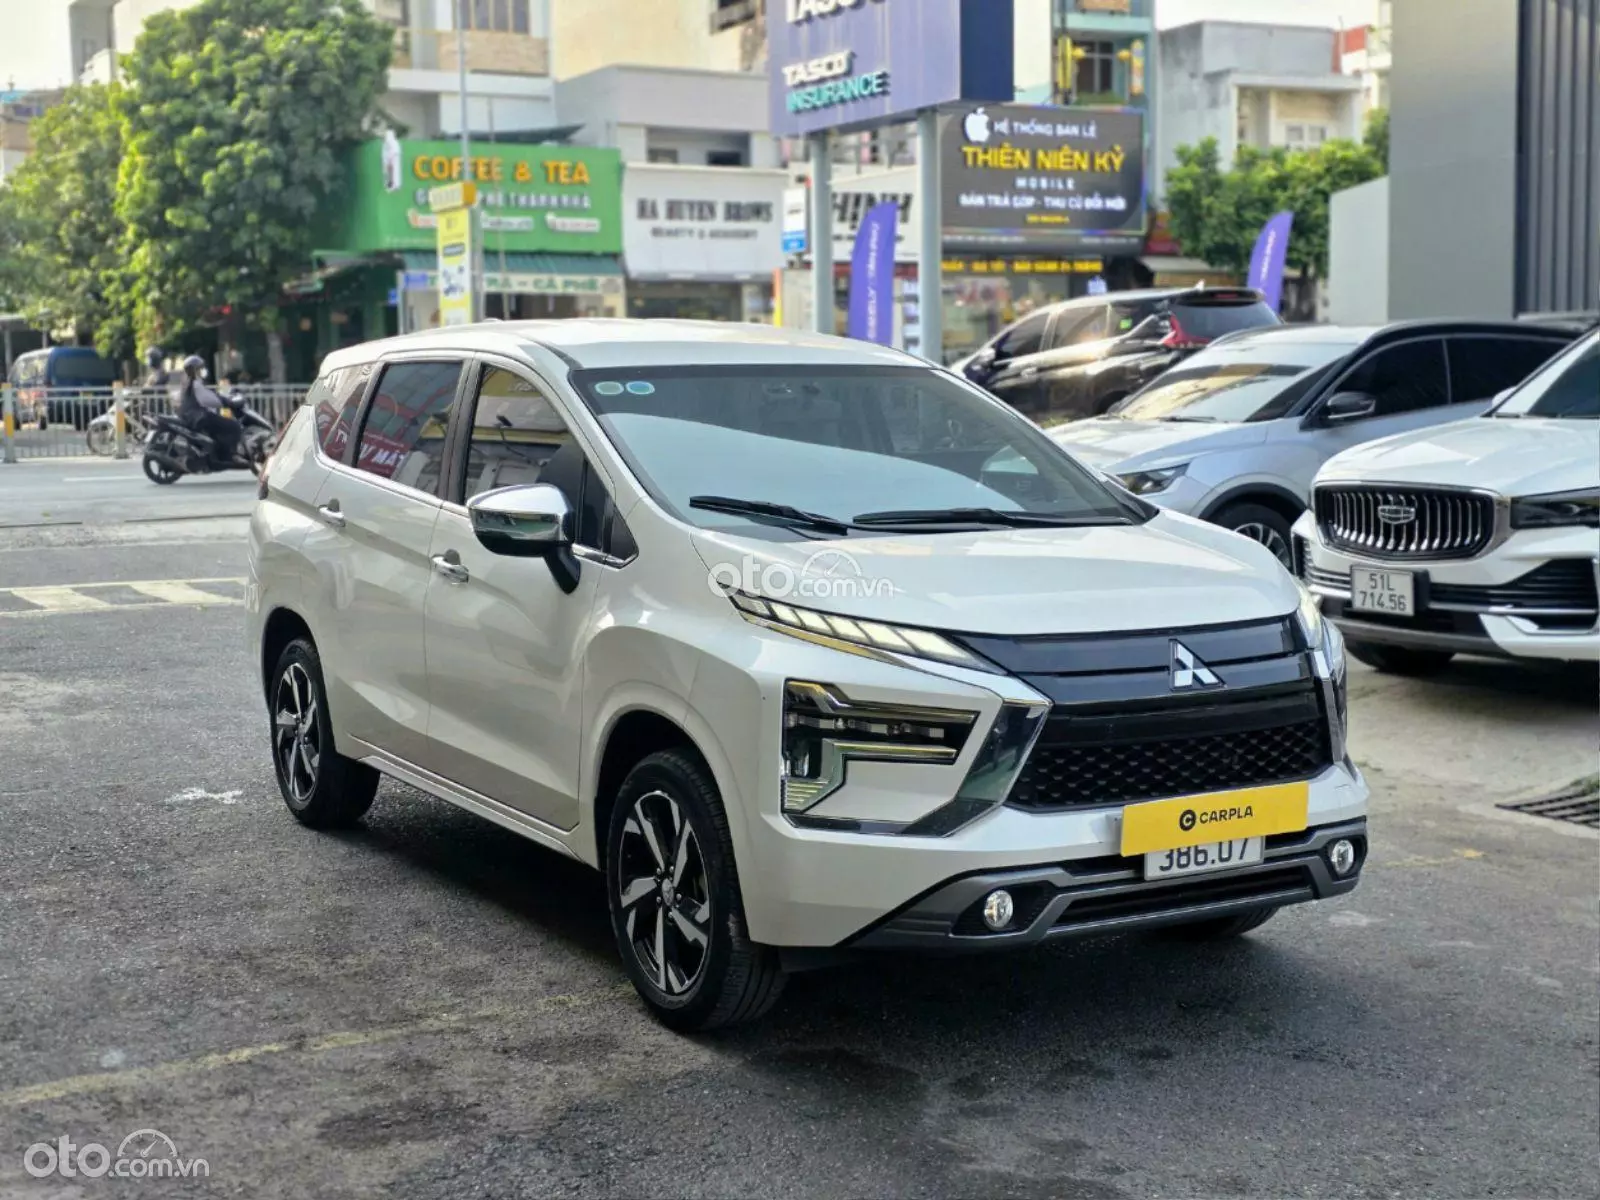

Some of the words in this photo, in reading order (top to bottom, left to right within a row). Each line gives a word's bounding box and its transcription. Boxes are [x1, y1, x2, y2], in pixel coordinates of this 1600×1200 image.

[782, 50, 852, 87] TASCO
[786, 69, 889, 113] INSURANCE
[413, 155, 504, 181] COFFEE
[515, 160, 532, 183] &
[543, 160, 590, 185] TEA
[961, 142, 1031, 169] THIÊN
[1036, 144, 1090, 171] NIÊN
[1369, 573, 1395, 591] 51L
[1360, 591, 1407, 612] 714.56
[1199, 806, 1254, 824] CARPLA
